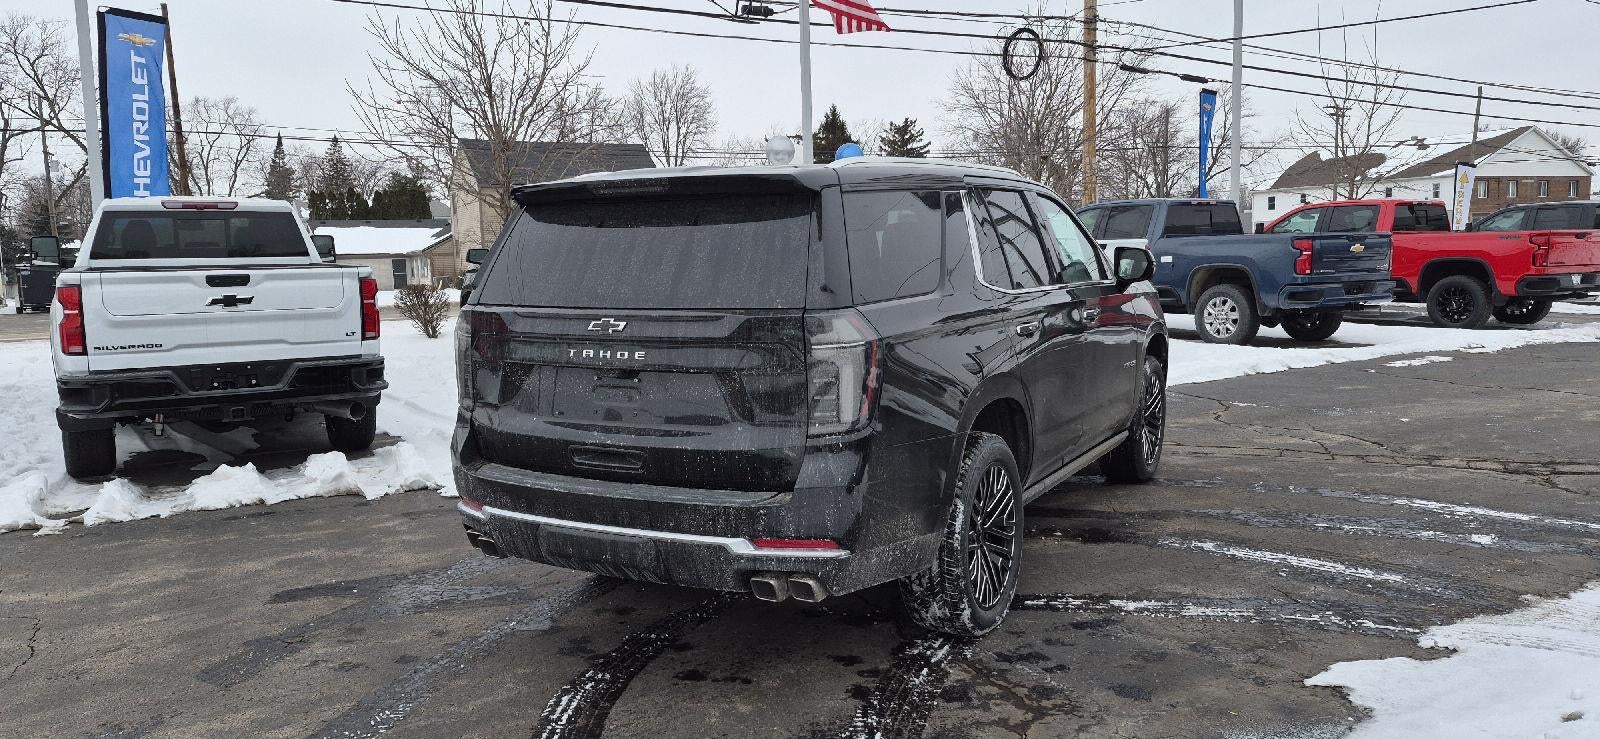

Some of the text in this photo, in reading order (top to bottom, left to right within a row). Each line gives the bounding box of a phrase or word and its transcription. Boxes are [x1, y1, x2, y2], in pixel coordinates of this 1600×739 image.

[131, 50, 150, 197] HEVROLET
[93, 343, 163, 351] SILVERADO
[568, 349, 646, 360] TAHOE
